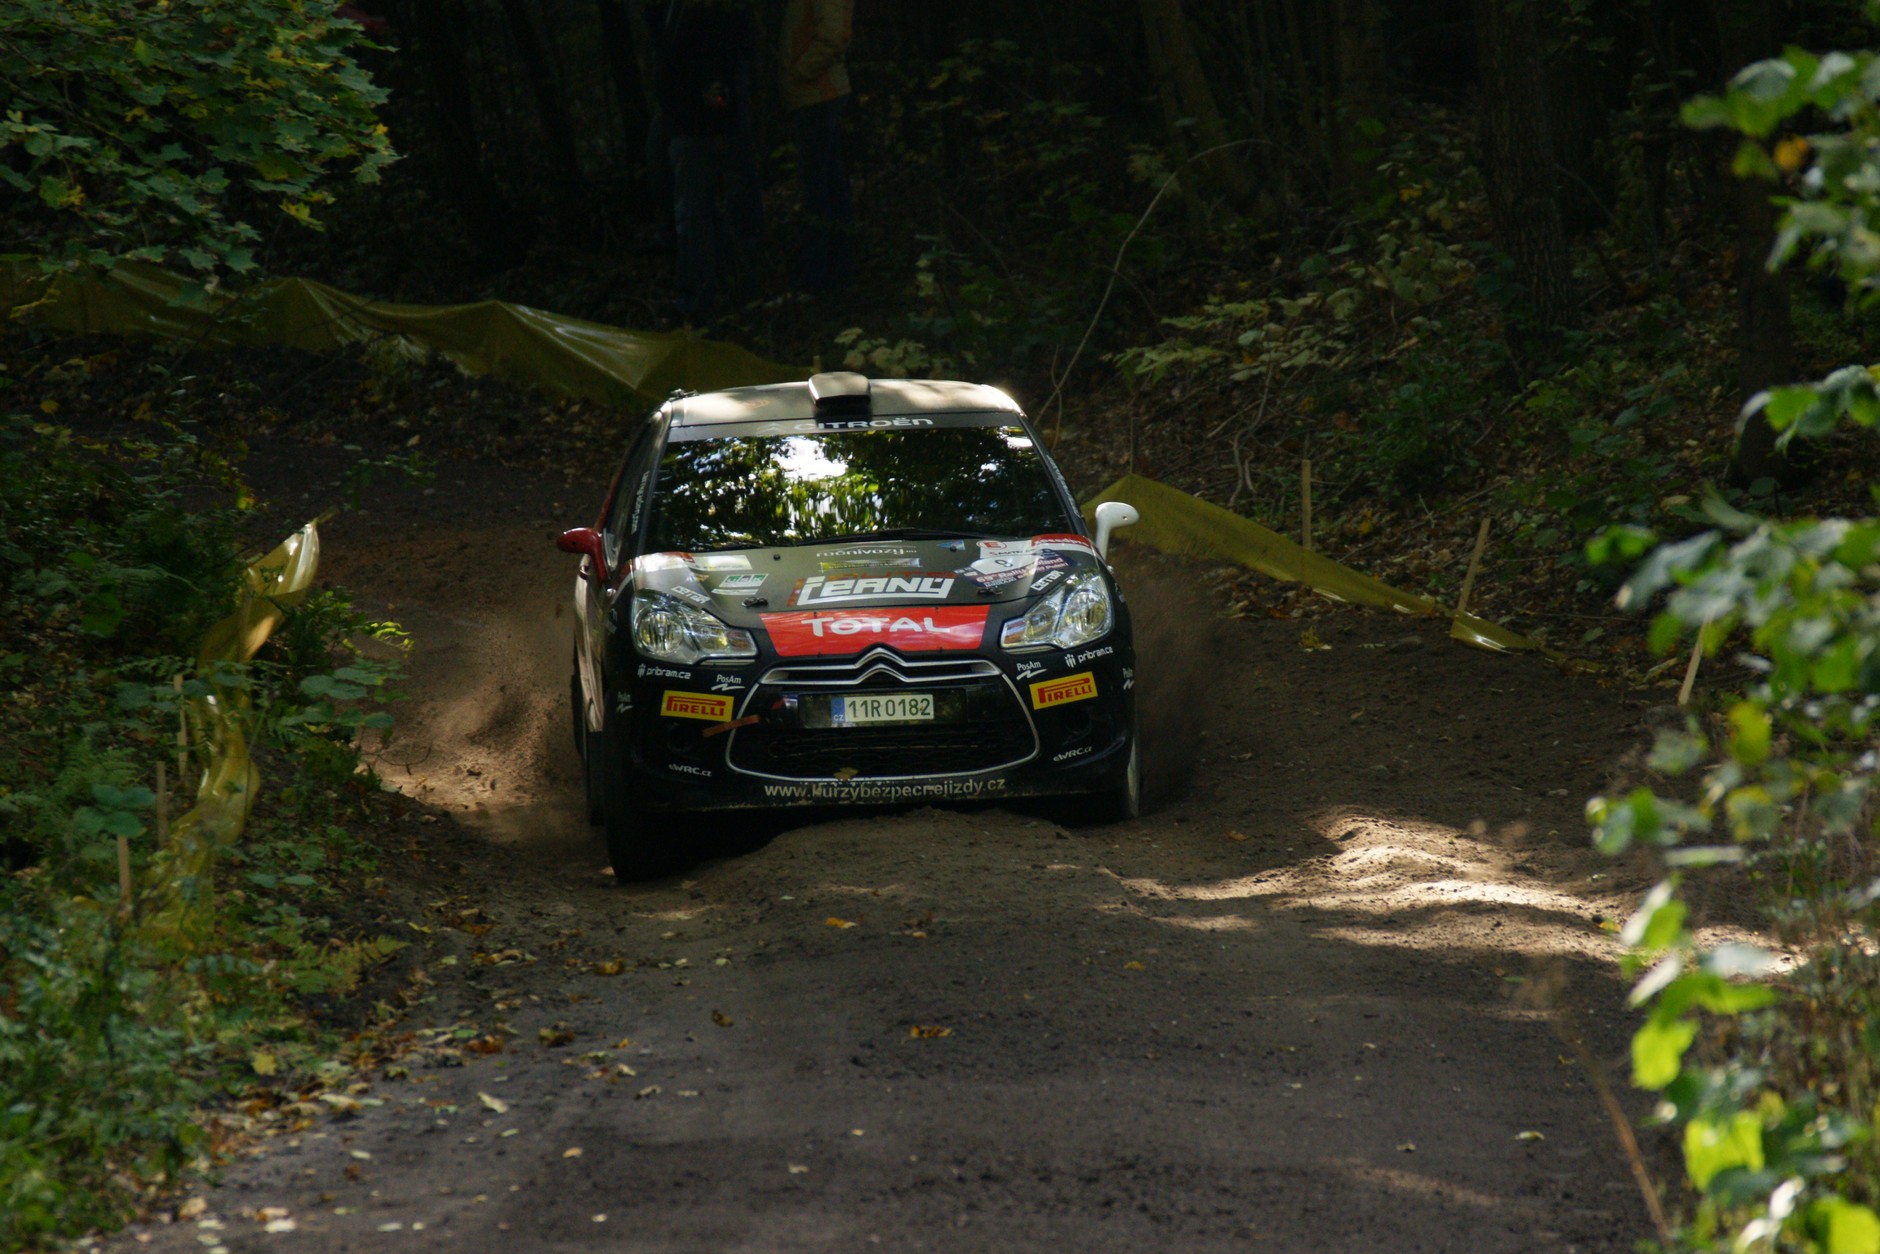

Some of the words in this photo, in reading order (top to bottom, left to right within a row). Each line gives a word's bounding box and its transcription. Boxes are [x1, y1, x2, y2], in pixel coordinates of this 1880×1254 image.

[801, 617, 953, 637] TOTAL
[1016, 661, 1042, 671] PosAm
[716, 674, 742, 684] PosAm
[1038, 677, 1093, 703] PIRELLI
[666, 695, 726, 716] PIRELLI
[886, 698, 931, 717] 0182
